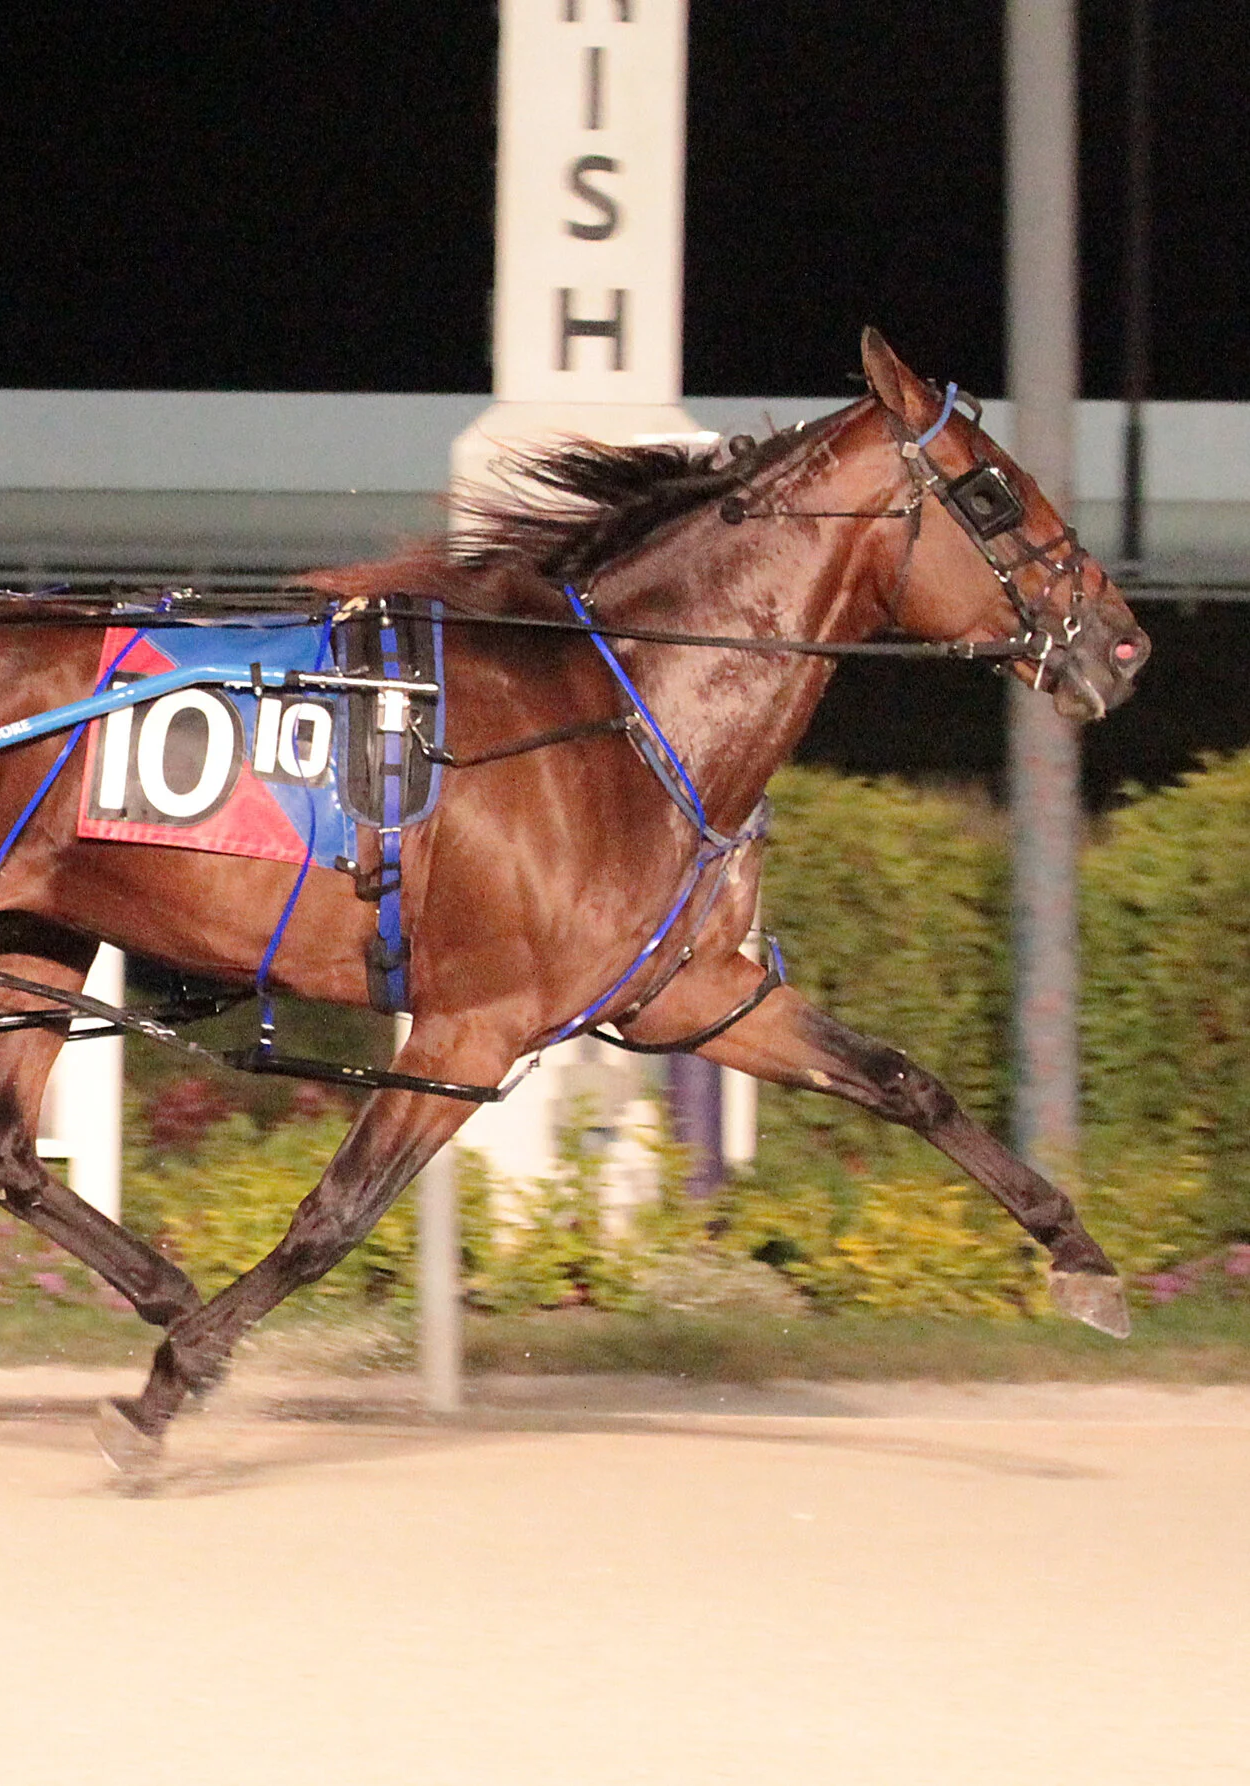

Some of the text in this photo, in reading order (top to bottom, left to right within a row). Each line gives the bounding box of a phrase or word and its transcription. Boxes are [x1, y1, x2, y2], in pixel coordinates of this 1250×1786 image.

[552, 0, 638, 372] ISH
[99, 681, 235, 818] 10
[253, 697, 332, 778] 10
